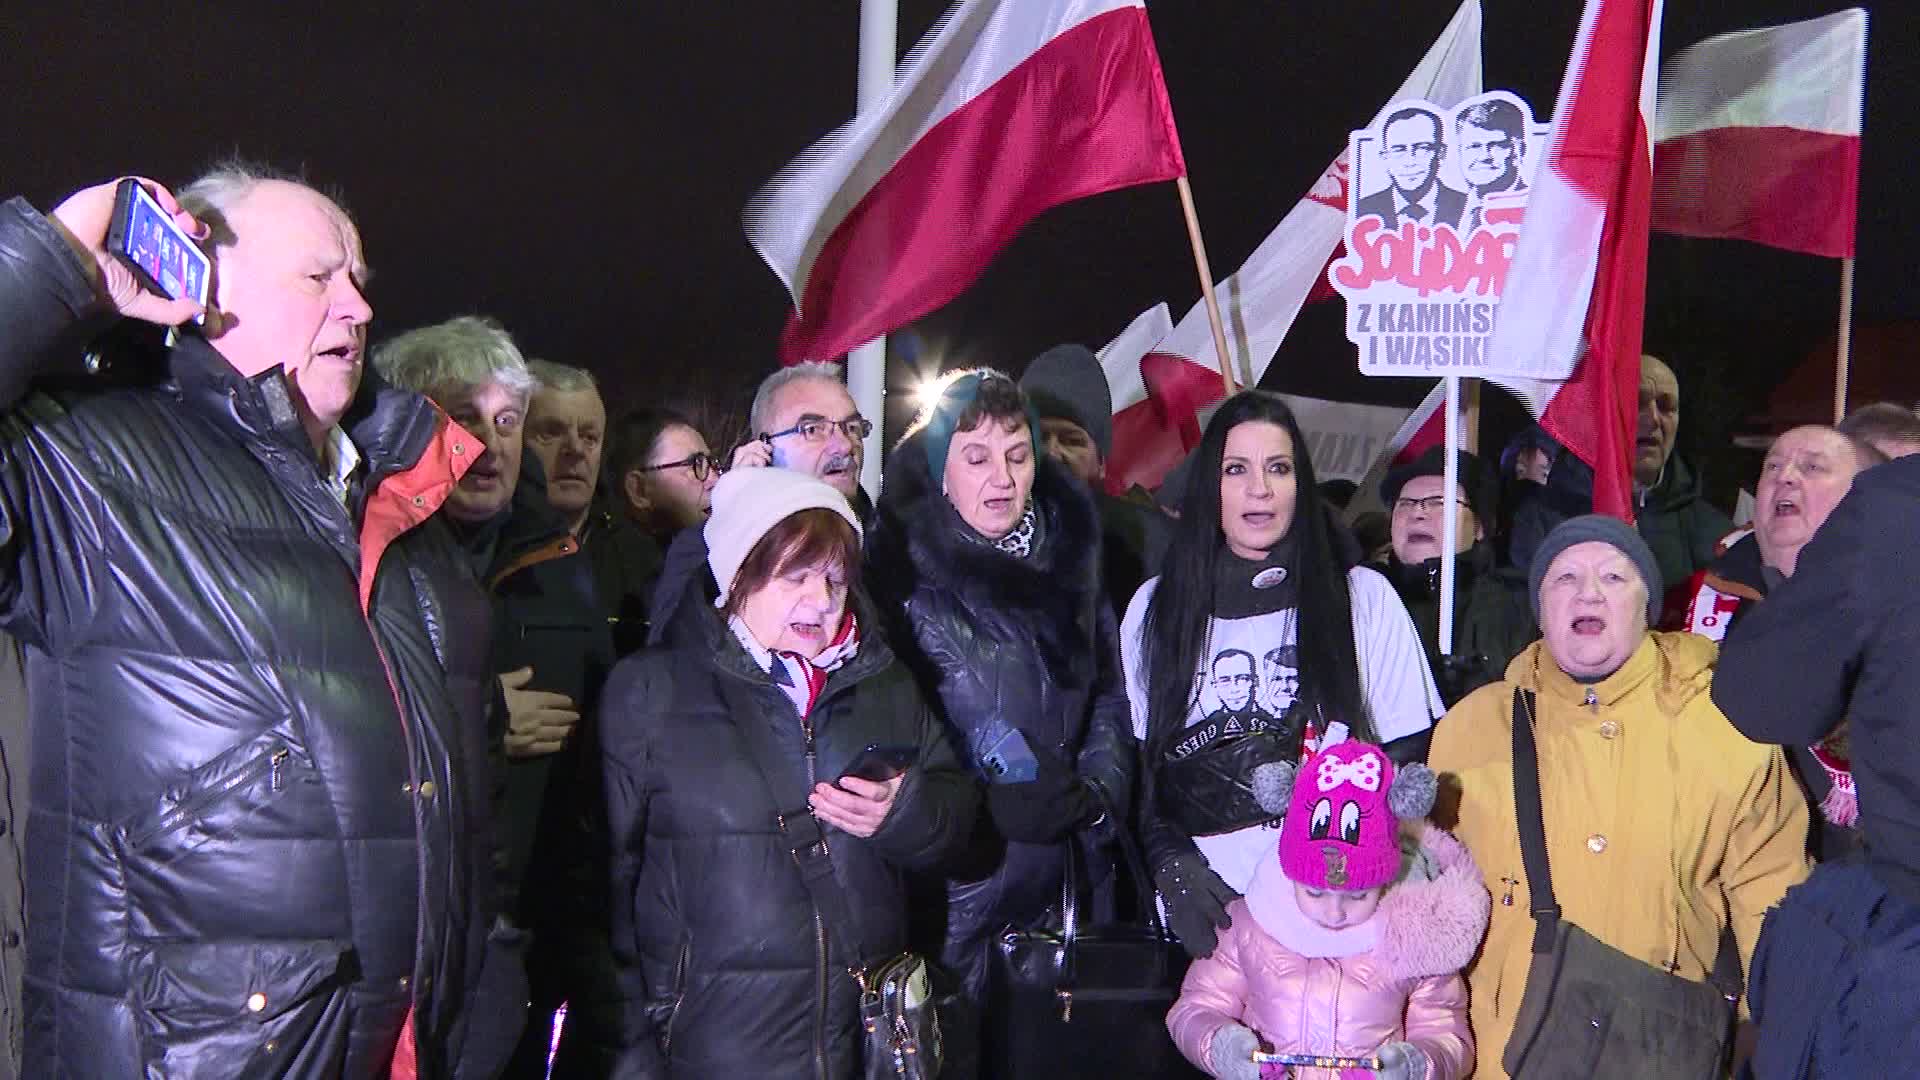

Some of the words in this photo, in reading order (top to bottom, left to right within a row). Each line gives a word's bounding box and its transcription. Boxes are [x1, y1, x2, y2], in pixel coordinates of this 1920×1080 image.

[1356, 303, 1372, 333] Z
[1378, 298, 1496, 334] KAMIŃS
[1368, 335, 1378, 365] I
